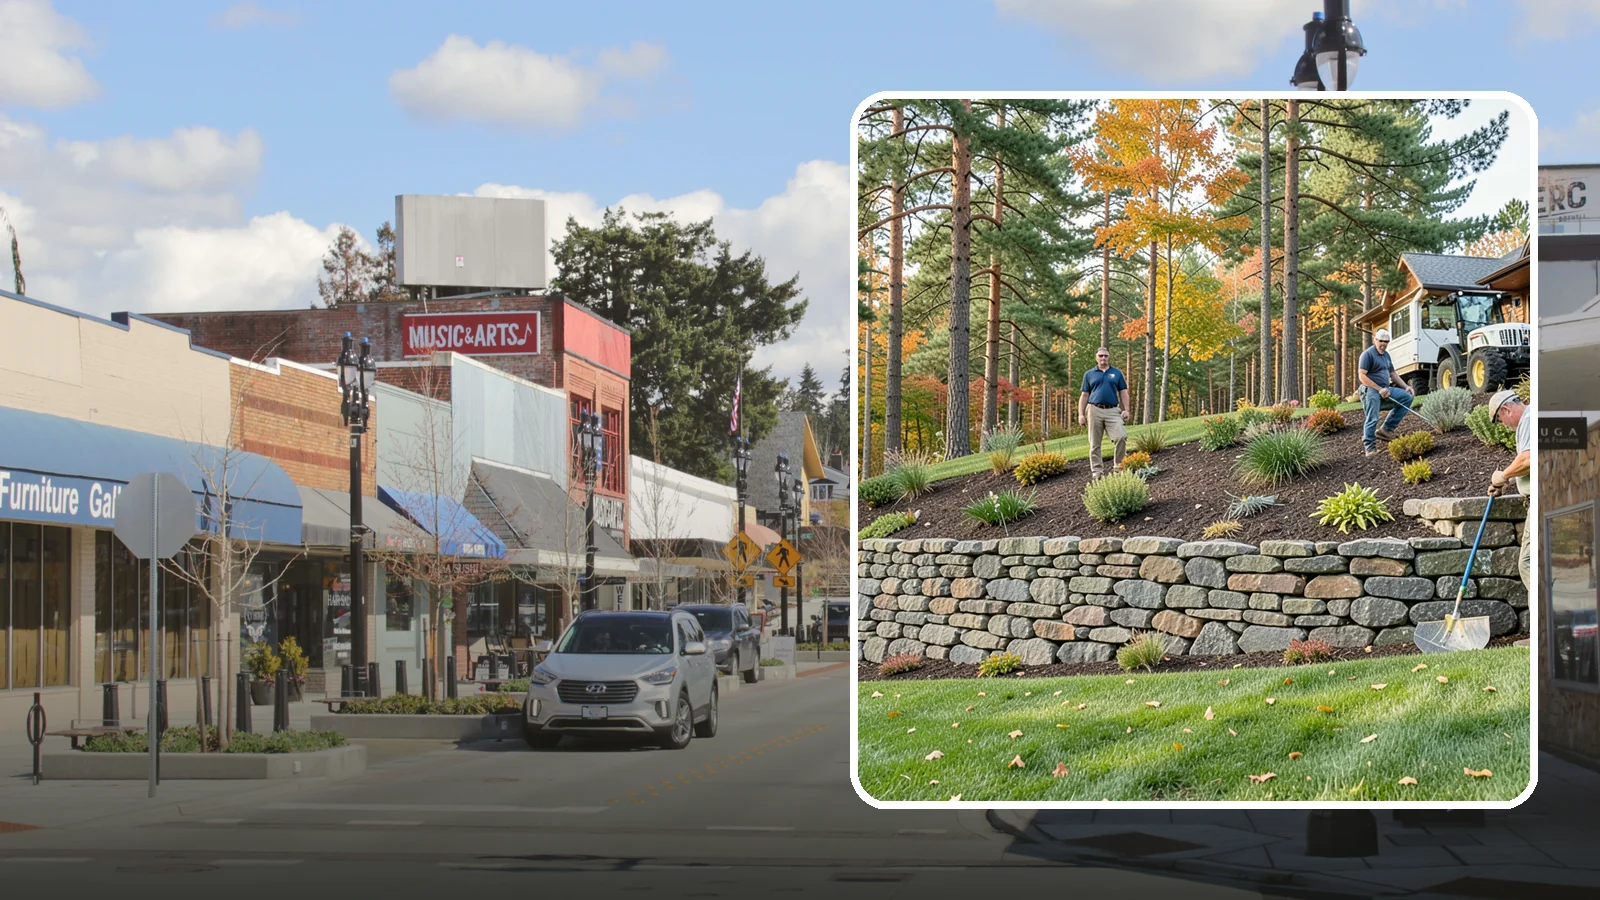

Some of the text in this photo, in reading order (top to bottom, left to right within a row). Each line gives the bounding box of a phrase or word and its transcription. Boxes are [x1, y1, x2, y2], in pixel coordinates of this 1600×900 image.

[1540, 427, 1577, 437] UGA
[0, 471, 79, 515] Furniture
[455, 563, 479, 573] SUSHI
